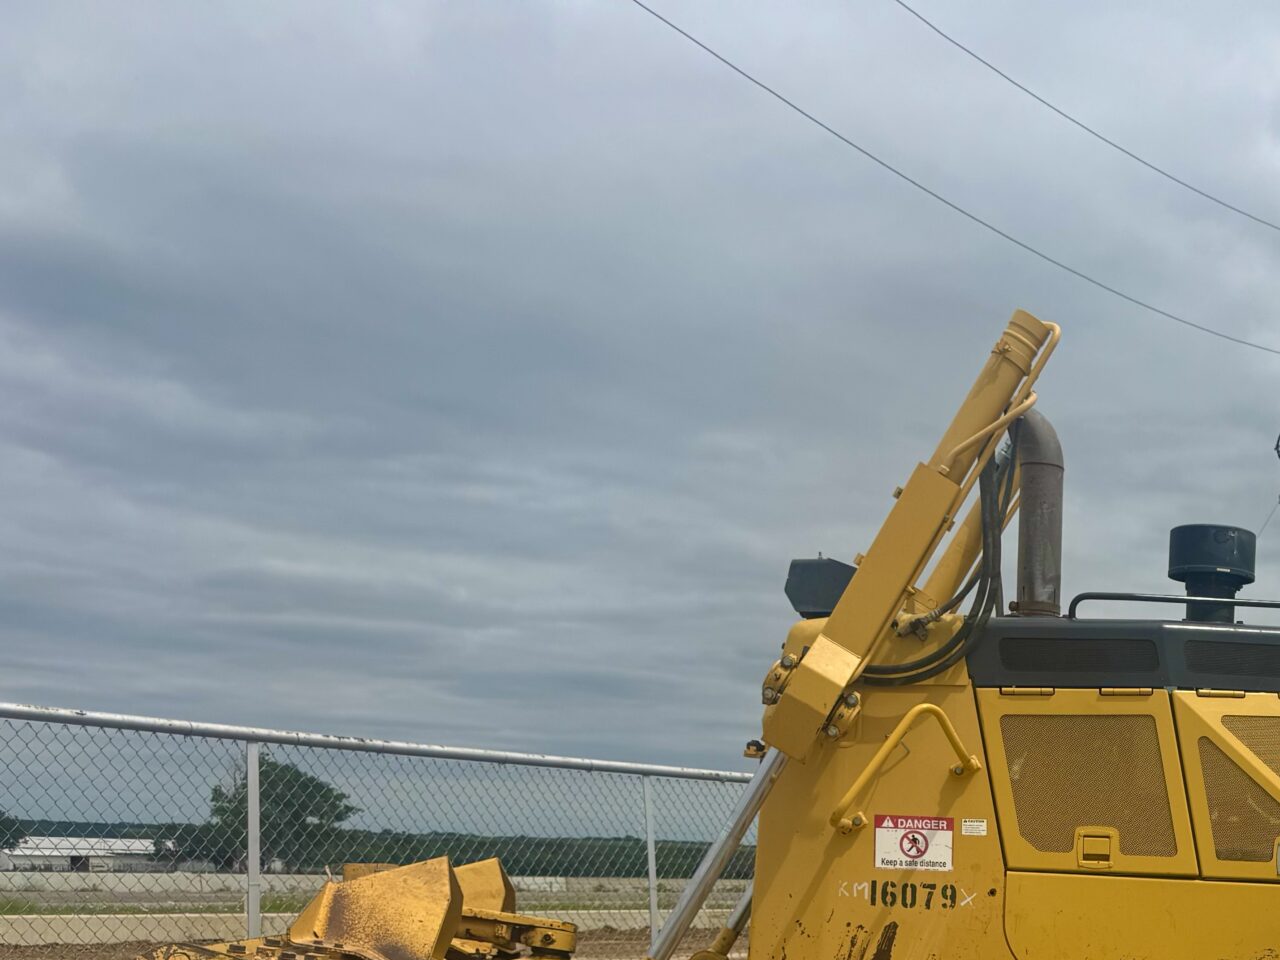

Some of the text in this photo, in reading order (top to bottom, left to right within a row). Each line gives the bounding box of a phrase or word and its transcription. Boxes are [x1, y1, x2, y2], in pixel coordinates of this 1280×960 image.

[897, 818, 947, 830] DANGER
[881, 858, 898, 867] Keep
[905, 859, 919, 867] safe
[920, 859, 947, 868] distance
[870, 879, 957, 910] 16079
